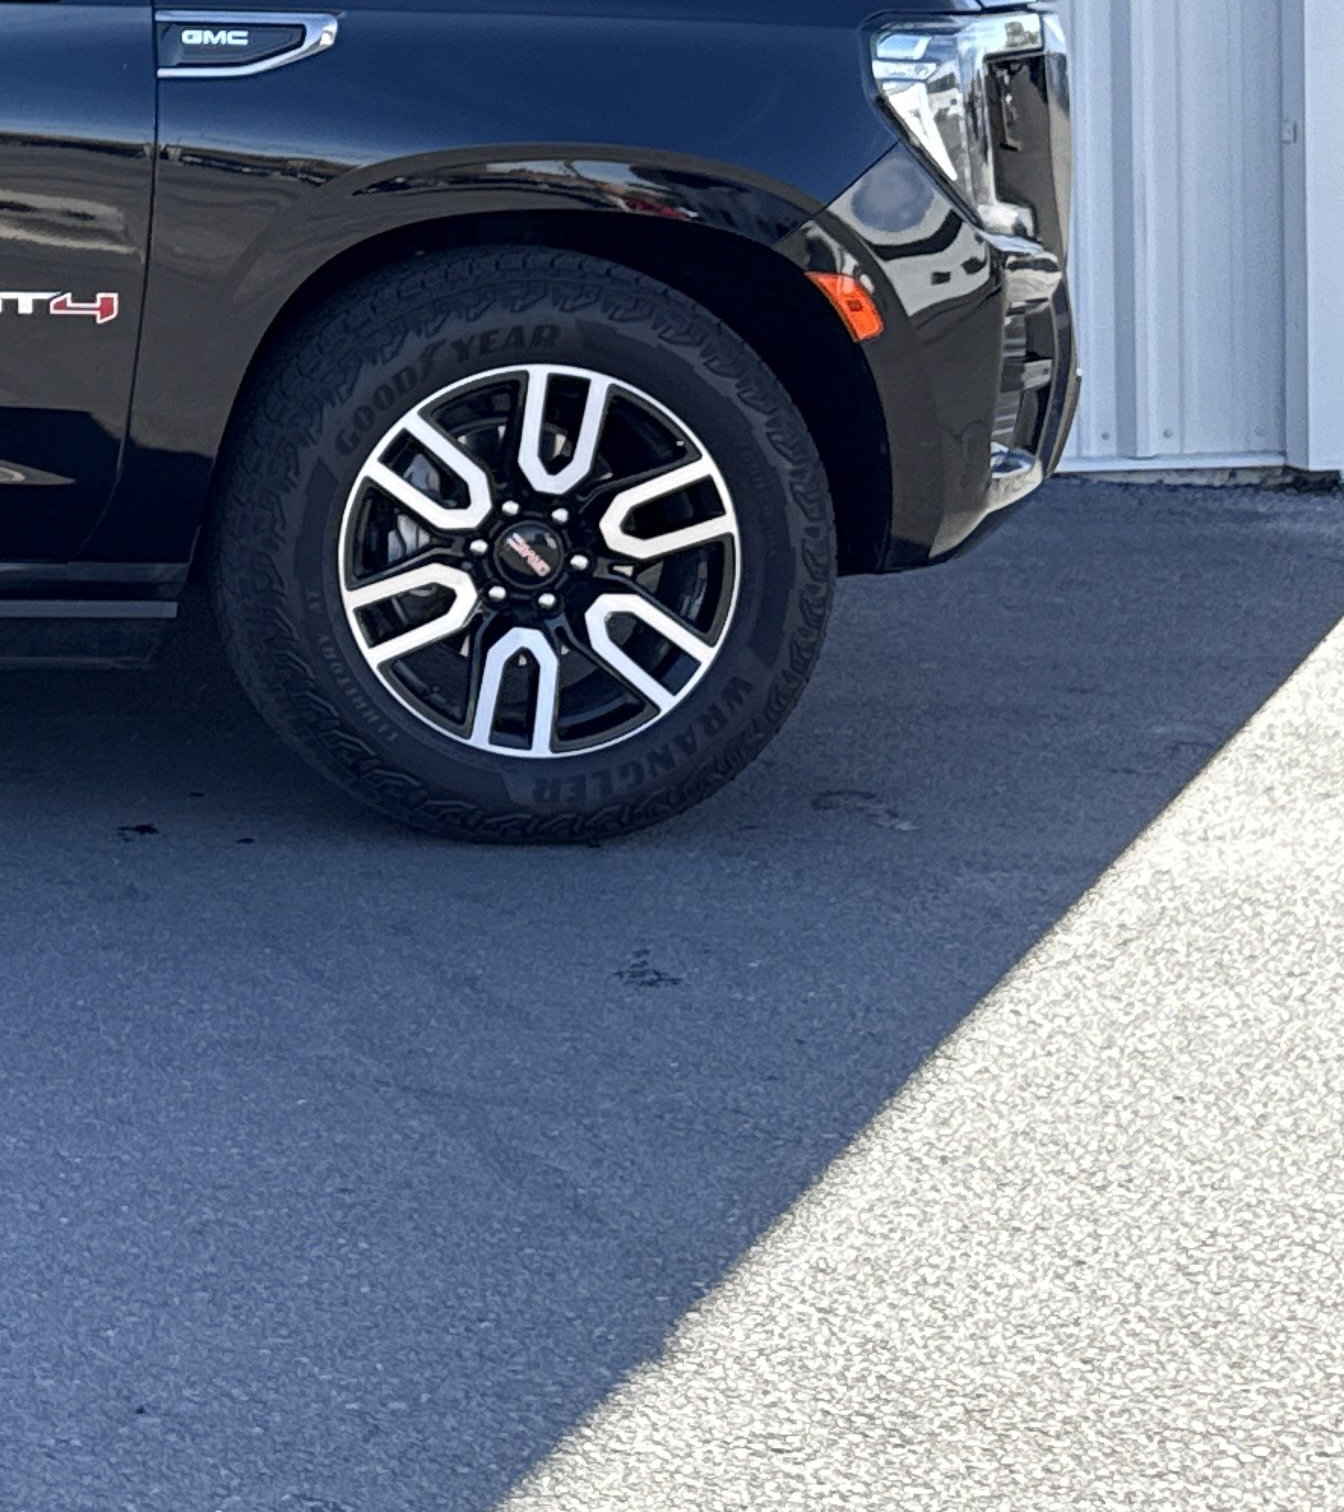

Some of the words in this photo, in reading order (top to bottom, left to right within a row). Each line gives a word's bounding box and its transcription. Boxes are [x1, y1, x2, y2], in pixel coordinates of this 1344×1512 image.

[180, 29, 249, 47] GMC
[333, 323, 562, 458] GOODYEAR
[532, 674, 754, 803] WRANGLER
